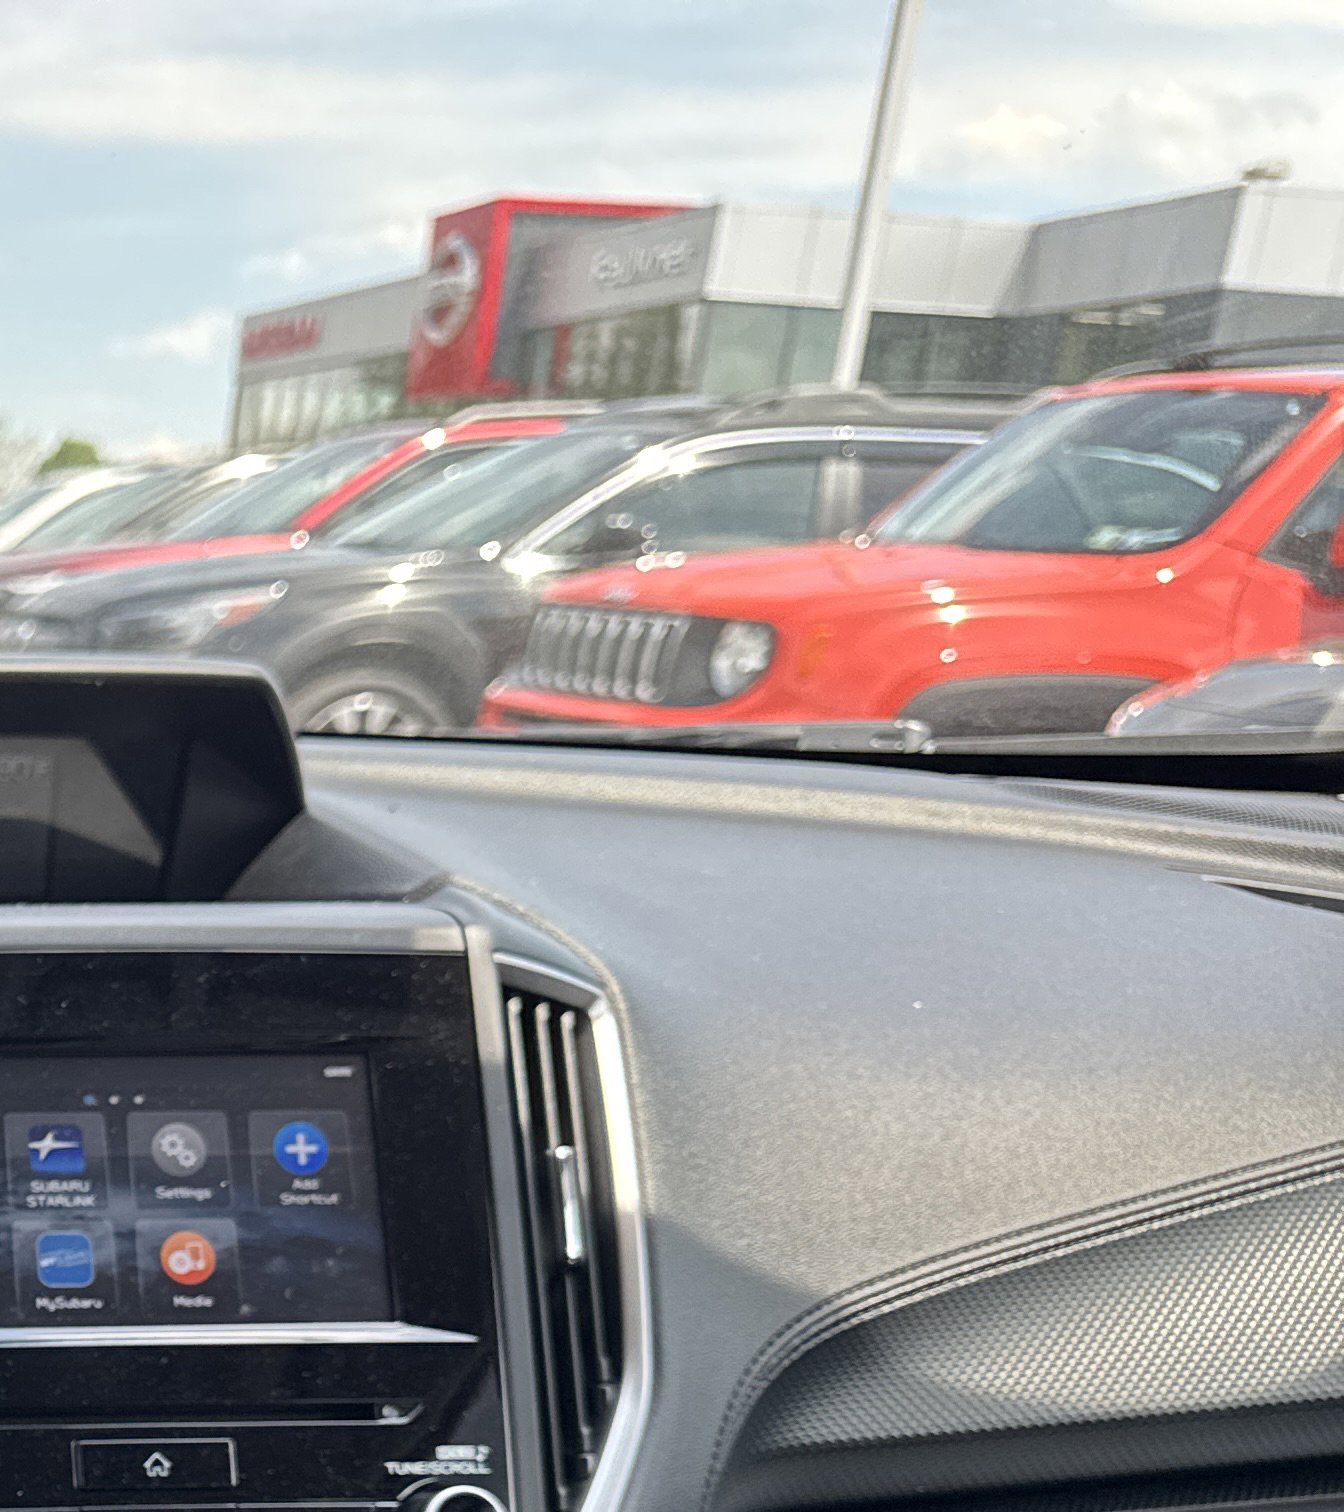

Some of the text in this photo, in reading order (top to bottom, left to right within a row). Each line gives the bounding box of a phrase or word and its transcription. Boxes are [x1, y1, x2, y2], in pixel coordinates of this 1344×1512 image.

[30, 1180, 91, 1193] SUBARU
[155, 1186, 213, 1201] Settings
[26, 1195, 96, 1208] STARLINK
[35, 1297, 103, 1312] MySubaru
